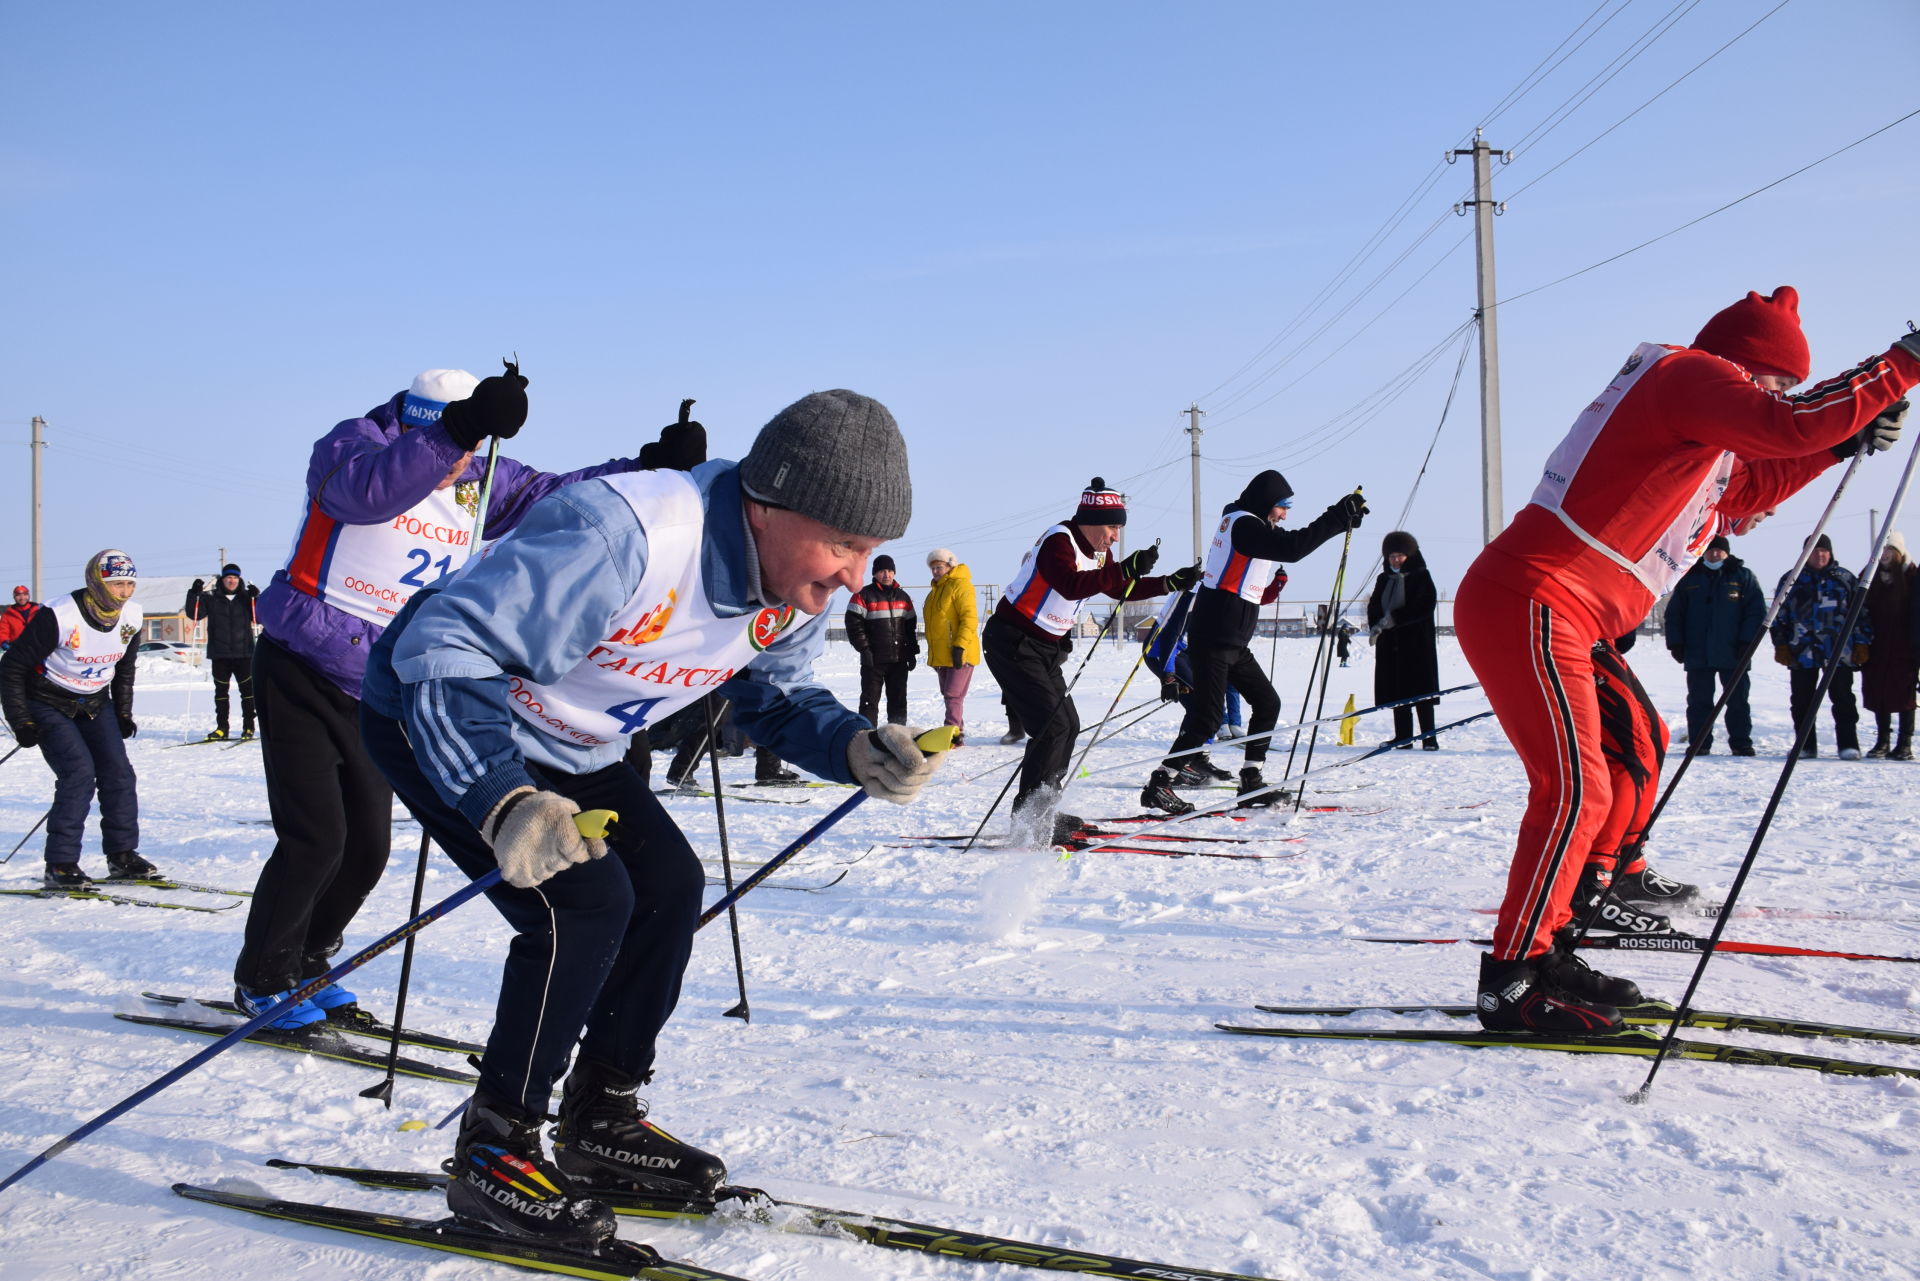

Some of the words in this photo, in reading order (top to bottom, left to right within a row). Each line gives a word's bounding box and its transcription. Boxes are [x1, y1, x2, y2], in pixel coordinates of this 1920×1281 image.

[393, 514, 470, 546] РОССИЯ
[399, 548, 453, 588] 21
[604, 696, 670, 735] 4
[1619, 937, 1700, 950] ROSSIGNOL
[1504, 980, 1531, 1003] TREK
[578, 1139, 681, 1169] SALOMON
[467, 1169, 561, 1220] SALOMON
[1132, 1268, 1228, 1281] FISC
